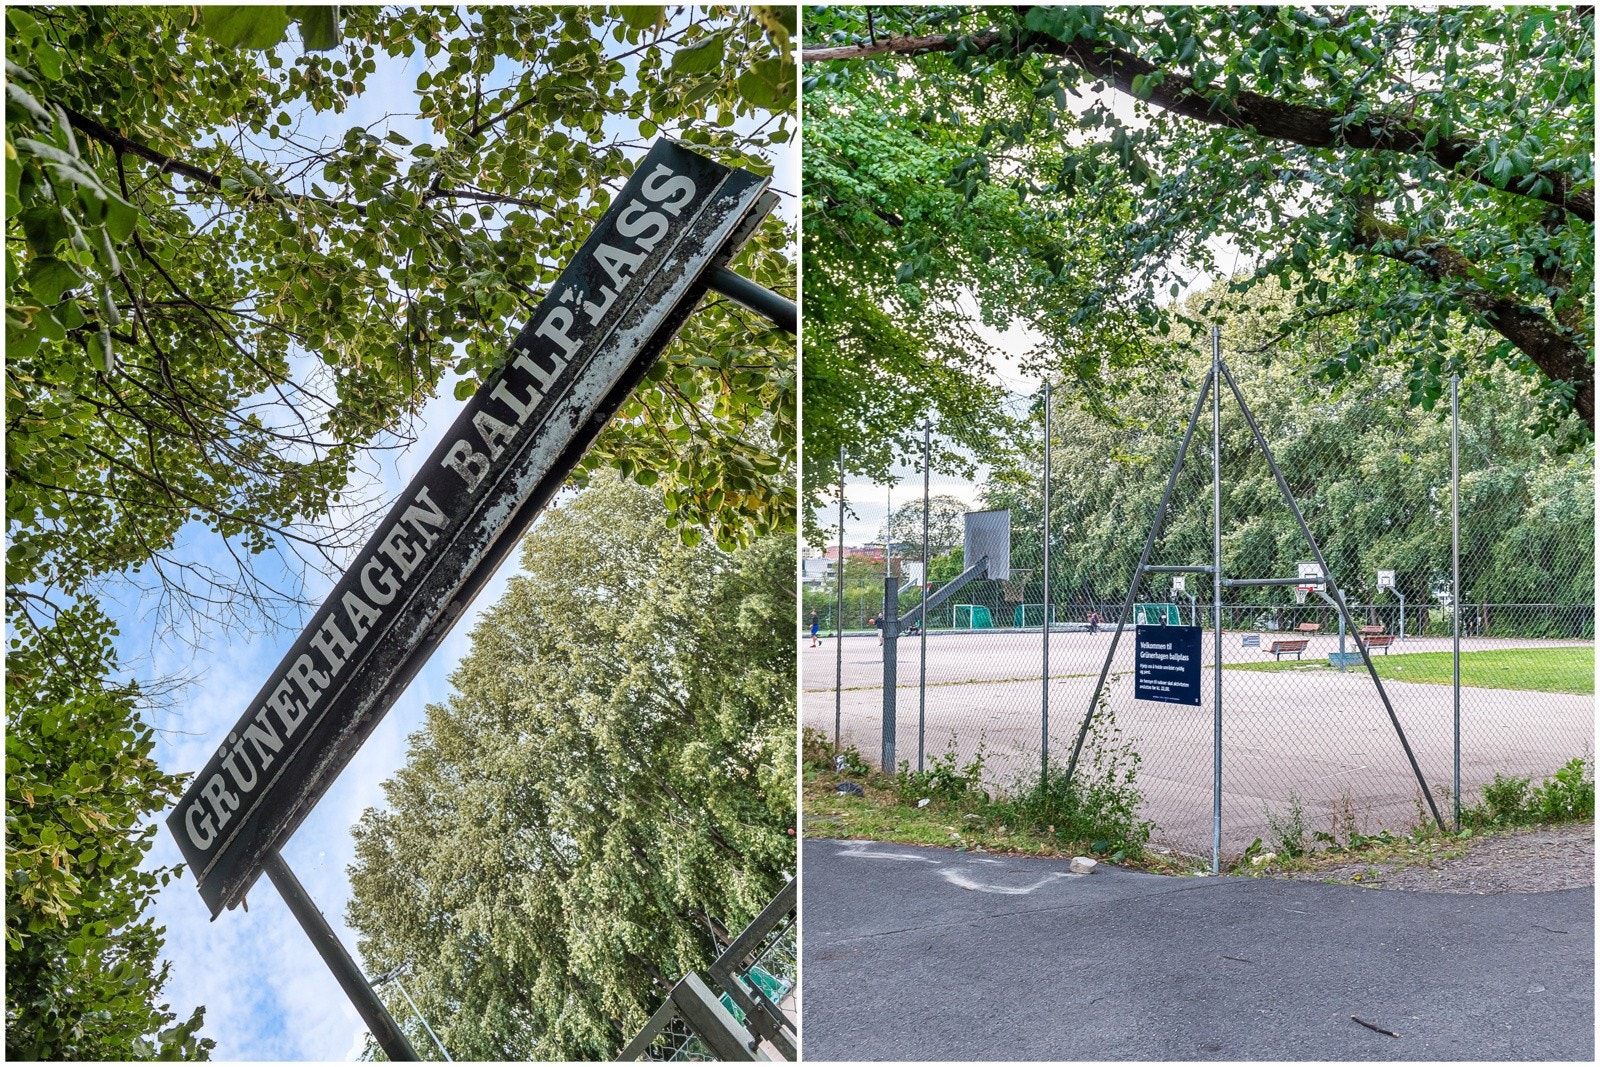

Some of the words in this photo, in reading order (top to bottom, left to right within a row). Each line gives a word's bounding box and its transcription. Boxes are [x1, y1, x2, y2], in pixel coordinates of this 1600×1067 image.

[184, 486, 450, 851] GRÜNERHAGEN
[442, 163, 697, 494] BALLPLASS
[1140, 642, 1166, 650] Velkommen
[1140, 651, 1168, 661] Grünerhagen
[1169, 653, 1189, 662] ballplass
